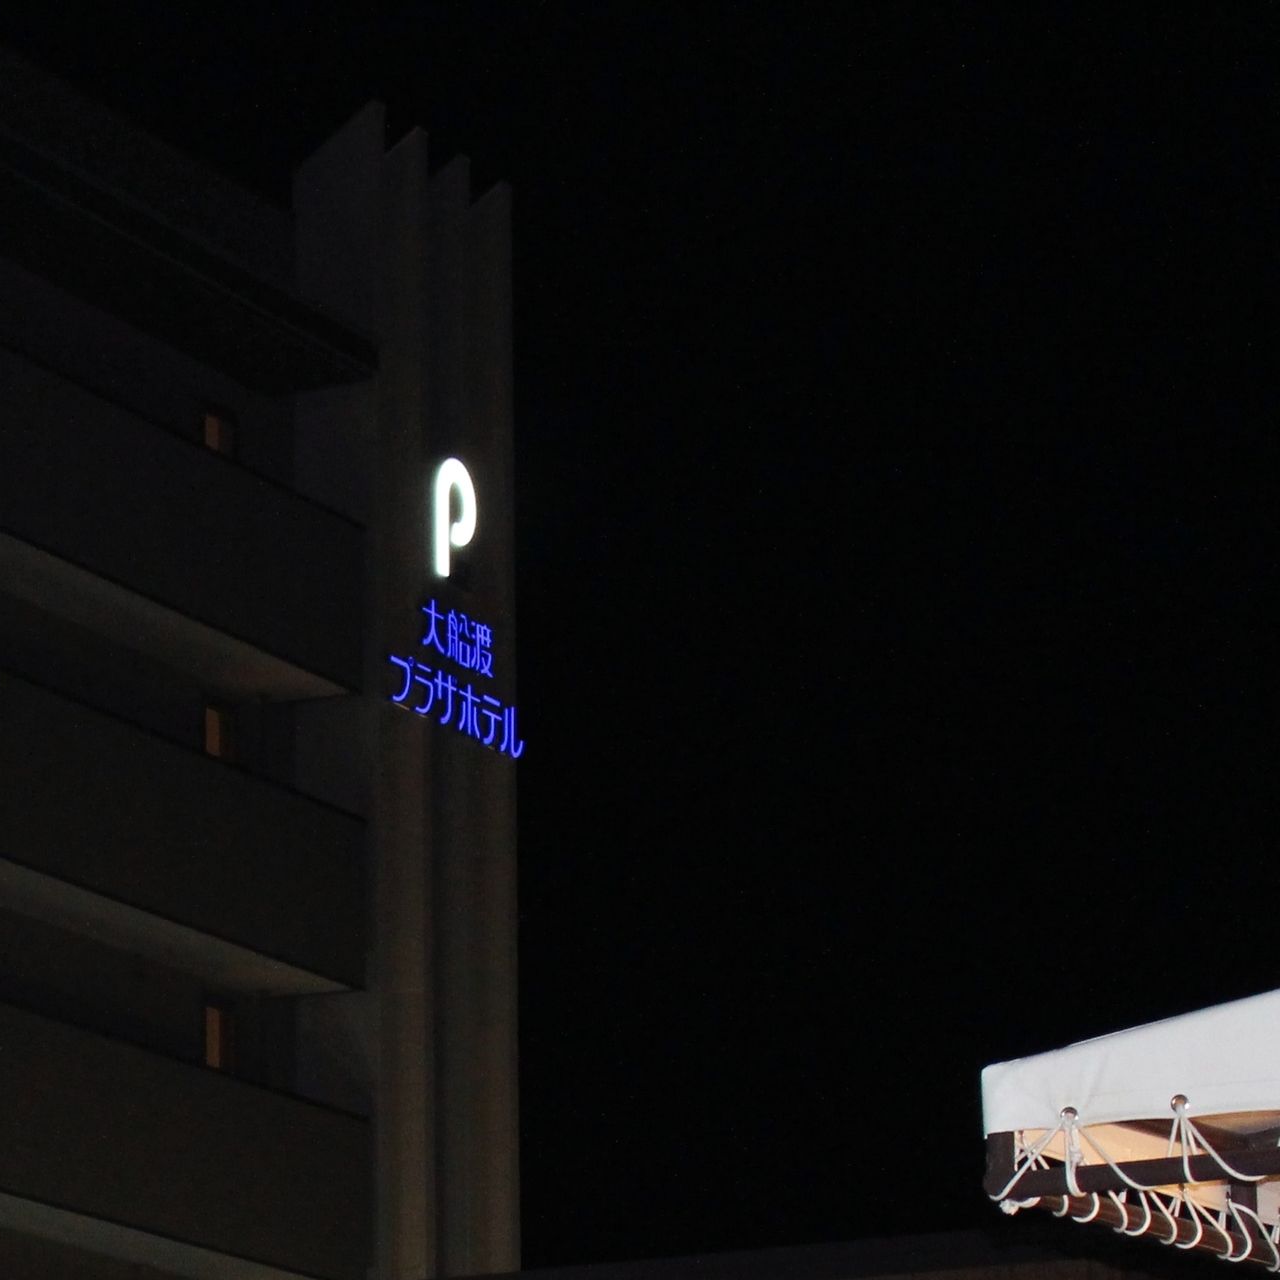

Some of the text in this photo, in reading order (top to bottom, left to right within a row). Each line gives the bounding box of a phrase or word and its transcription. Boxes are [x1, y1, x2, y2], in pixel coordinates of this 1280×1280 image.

[422, 599, 493, 678] 大船渡
[390, 656, 524, 758] プラザホテル
